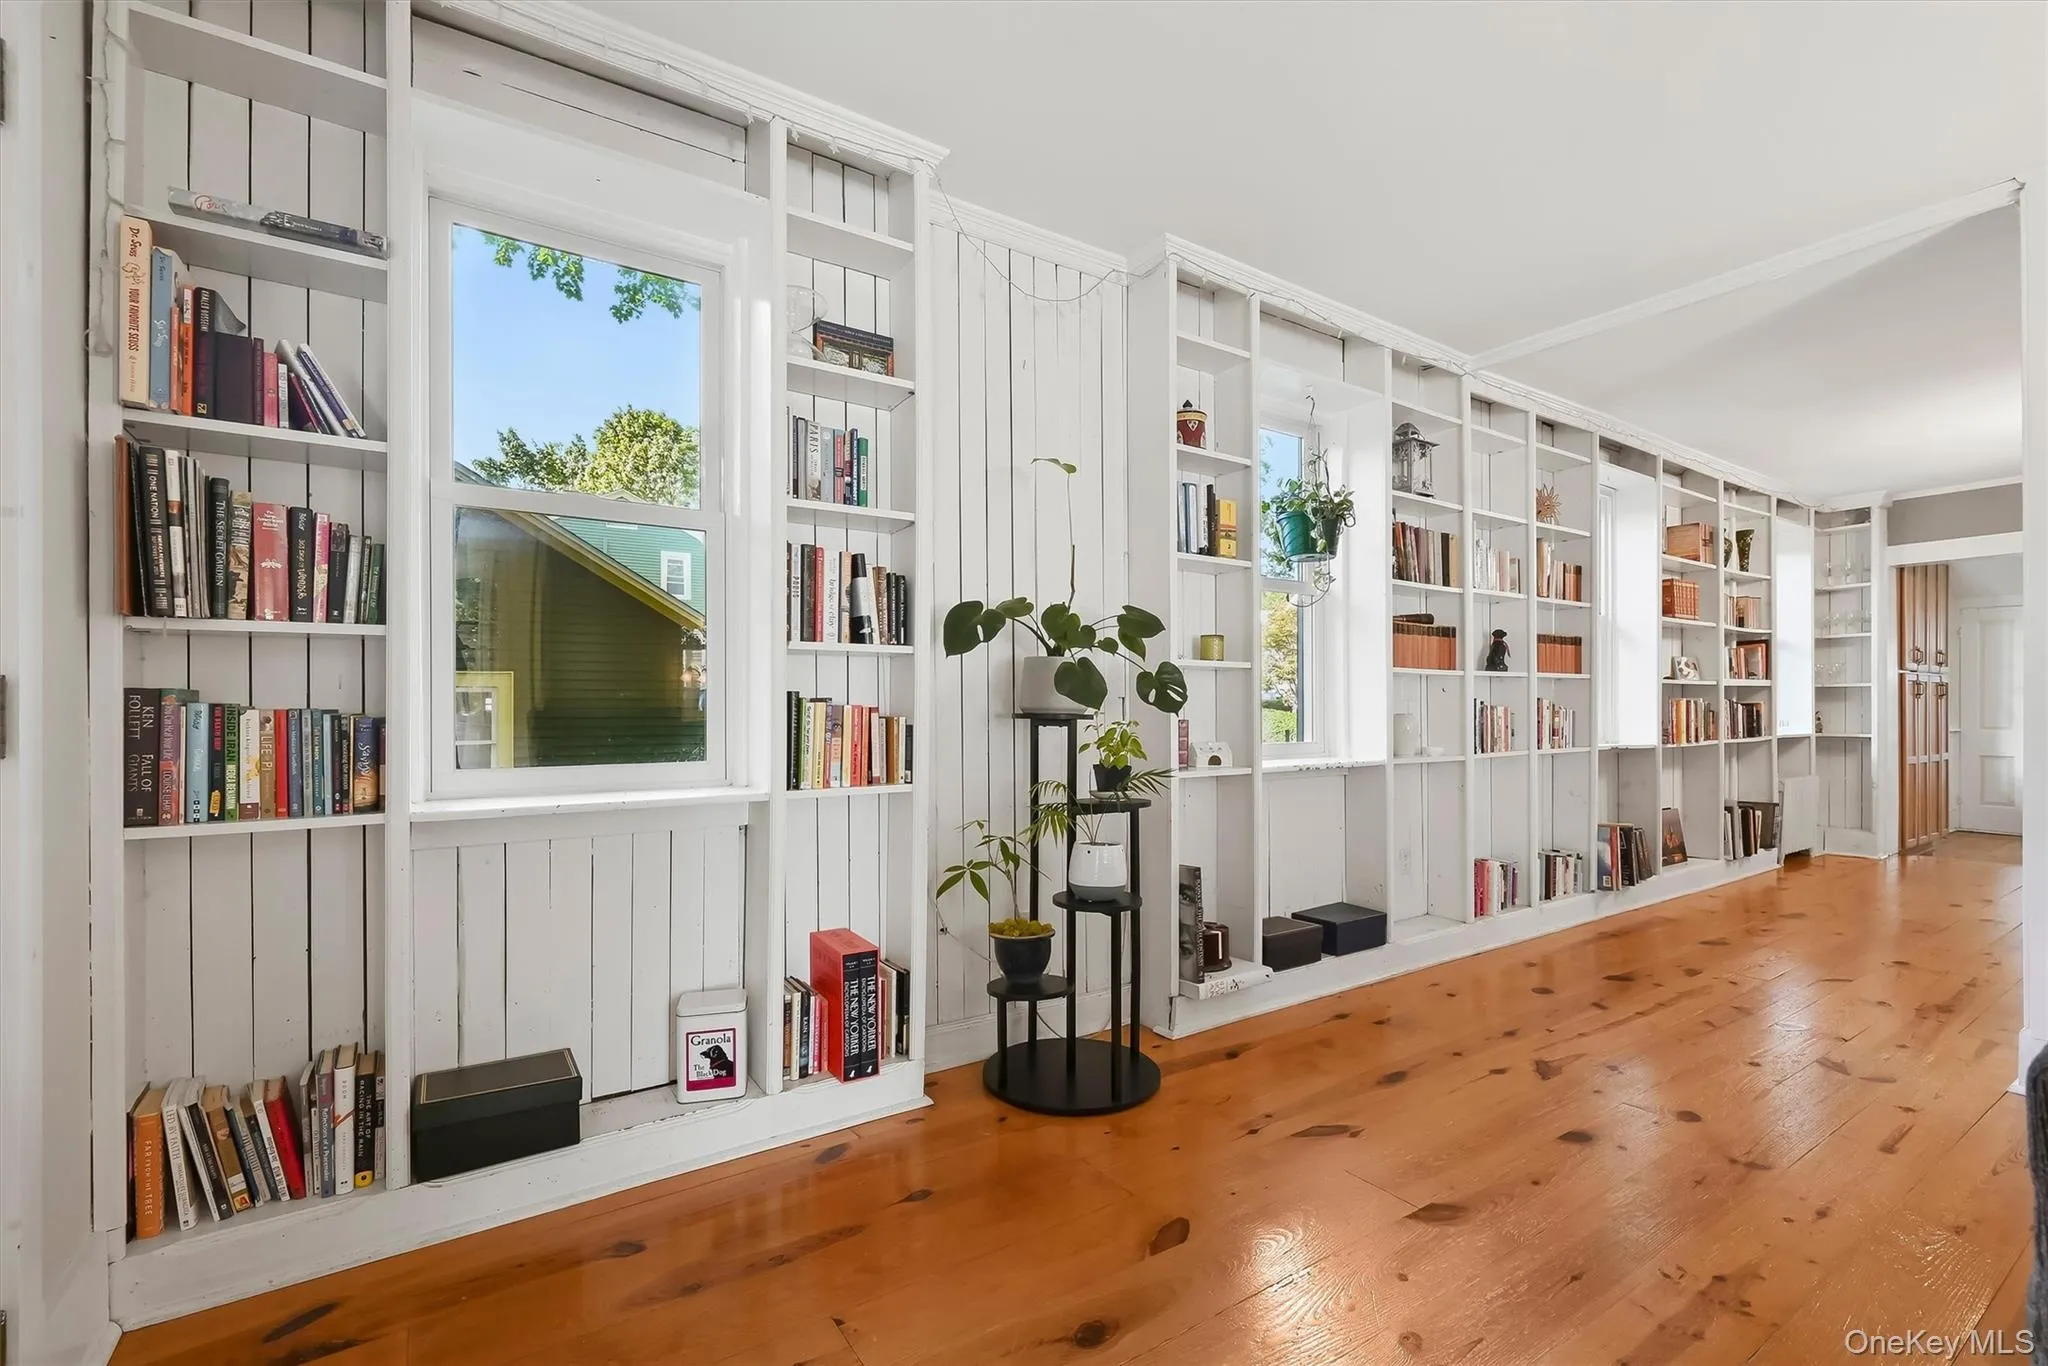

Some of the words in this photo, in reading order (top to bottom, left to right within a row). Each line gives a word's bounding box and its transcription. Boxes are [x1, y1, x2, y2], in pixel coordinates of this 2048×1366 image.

[129, 226, 140, 239] Dr.
[129, 239, 141, 257] Seuss
[127, 288, 139, 304] YOUR
[128, 304, 139, 331] FAVORITE
[128, 331, 139, 351] SEUSS
[809, 424, 818, 453] PARIS
[149, 476, 157, 491] ONE
[150, 492, 159, 518] NATION
[216, 501, 225, 518] THE
[216, 520, 225, 549] SECRET
[215, 552, 225, 587] GARDEN
[129, 695, 140, 739] FOLLETT
[142, 706, 154, 728] KEN
[227, 706, 236, 736] INSIDE
[227, 740, 236, 762] IRAN
[261, 736, 272, 753] LIFE
[127, 754, 138, 792] GIANTS
[142, 754, 153, 775] FALL
[262, 762, 272, 771] PI
[141, 779, 151, 792] OF
[850, 979, 858, 997] THE
[867, 975, 875, 993] THE
[850, 998, 859, 1018] NEW
[867, 994, 876, 1014] NEW
[691, 1033, 731, 1046] Granola
[850, 1019, 859, 1055] YORKER
[867, 1014, 876, 1051] YORKER
[713, 1069, 727, 1077] Dog
[166, 1109, 175, 1123] LED
[359, 1111, 364, 1119] IN
[168, 1126, 176, 1136] BY
[365, 1129, 371, 1138] OF
[170, 1137, 180, 1160] FAITH
